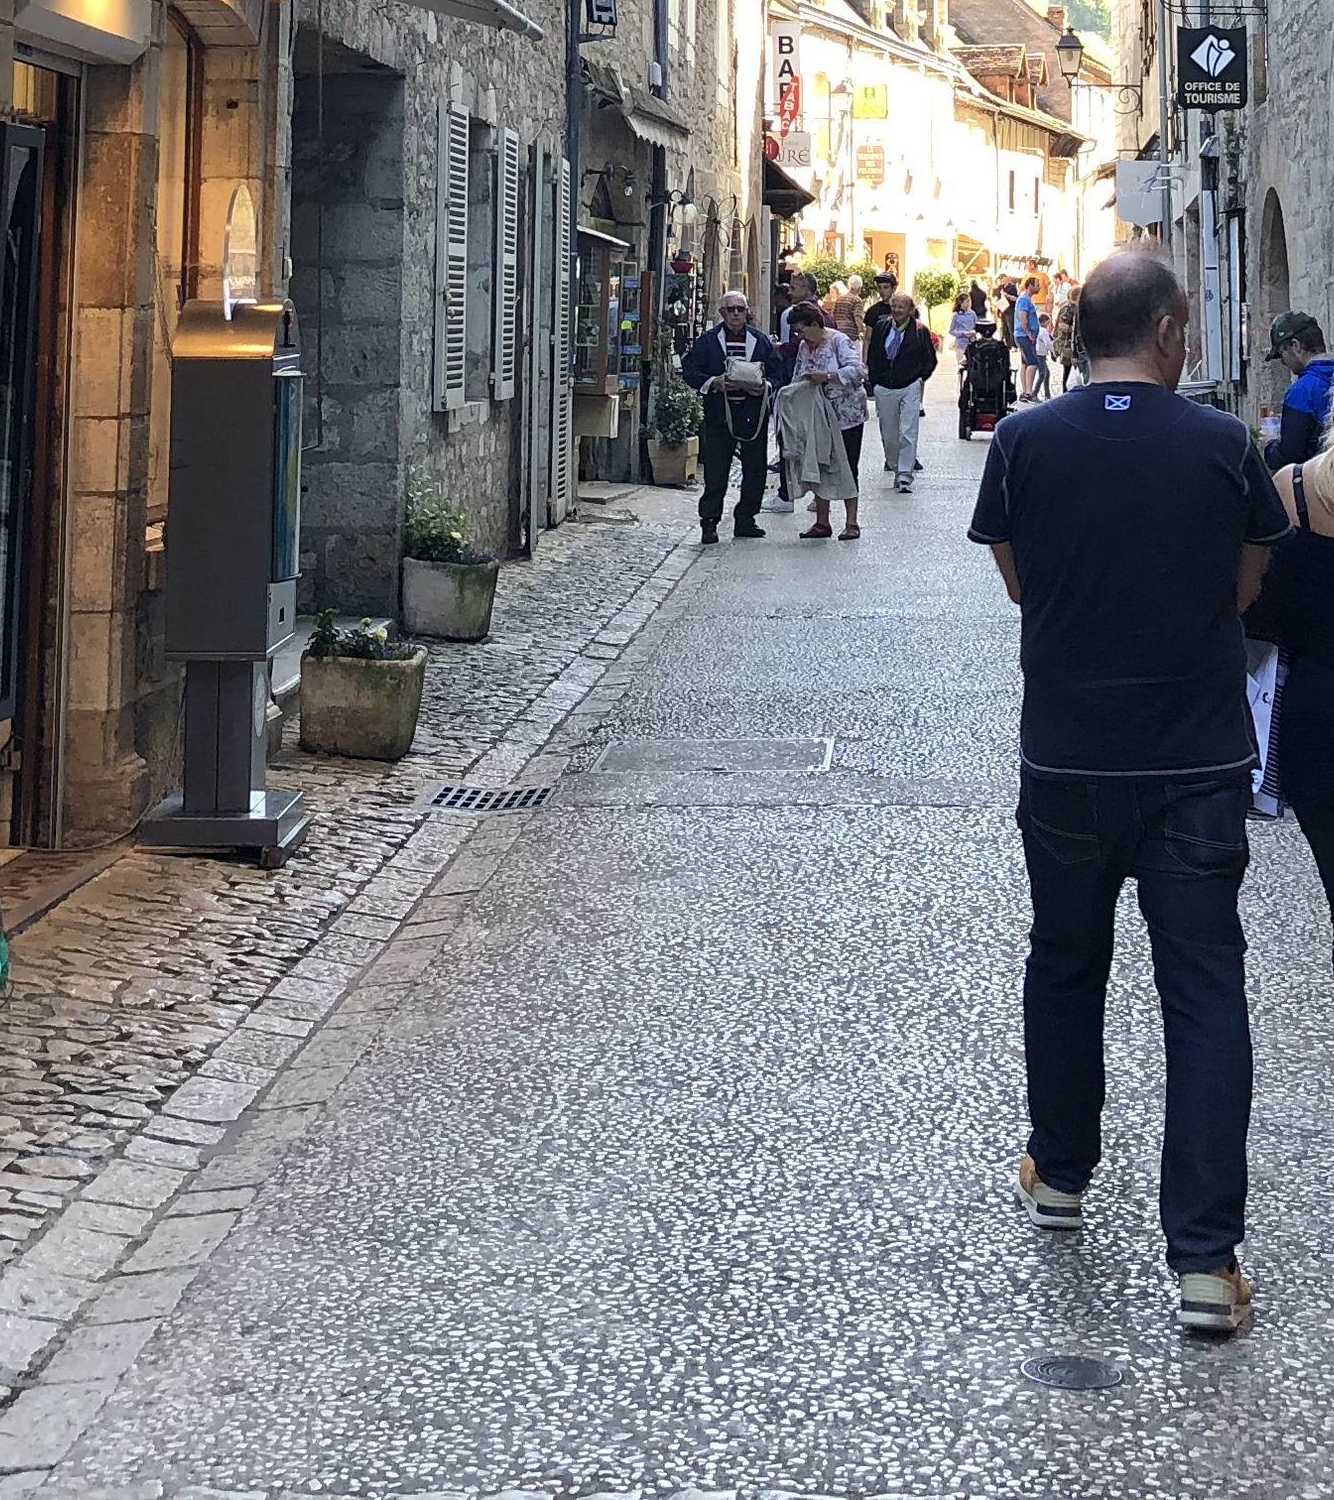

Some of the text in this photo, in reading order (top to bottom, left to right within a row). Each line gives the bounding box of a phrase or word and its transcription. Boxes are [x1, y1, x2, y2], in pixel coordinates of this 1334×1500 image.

[1184, 82, 1240, 91] OFFICE DE
[1184, 92, 1241, 104] TOURISME
[781, 82, 798, 131] TABAC
[776, 147, 810, 166] URÉ
